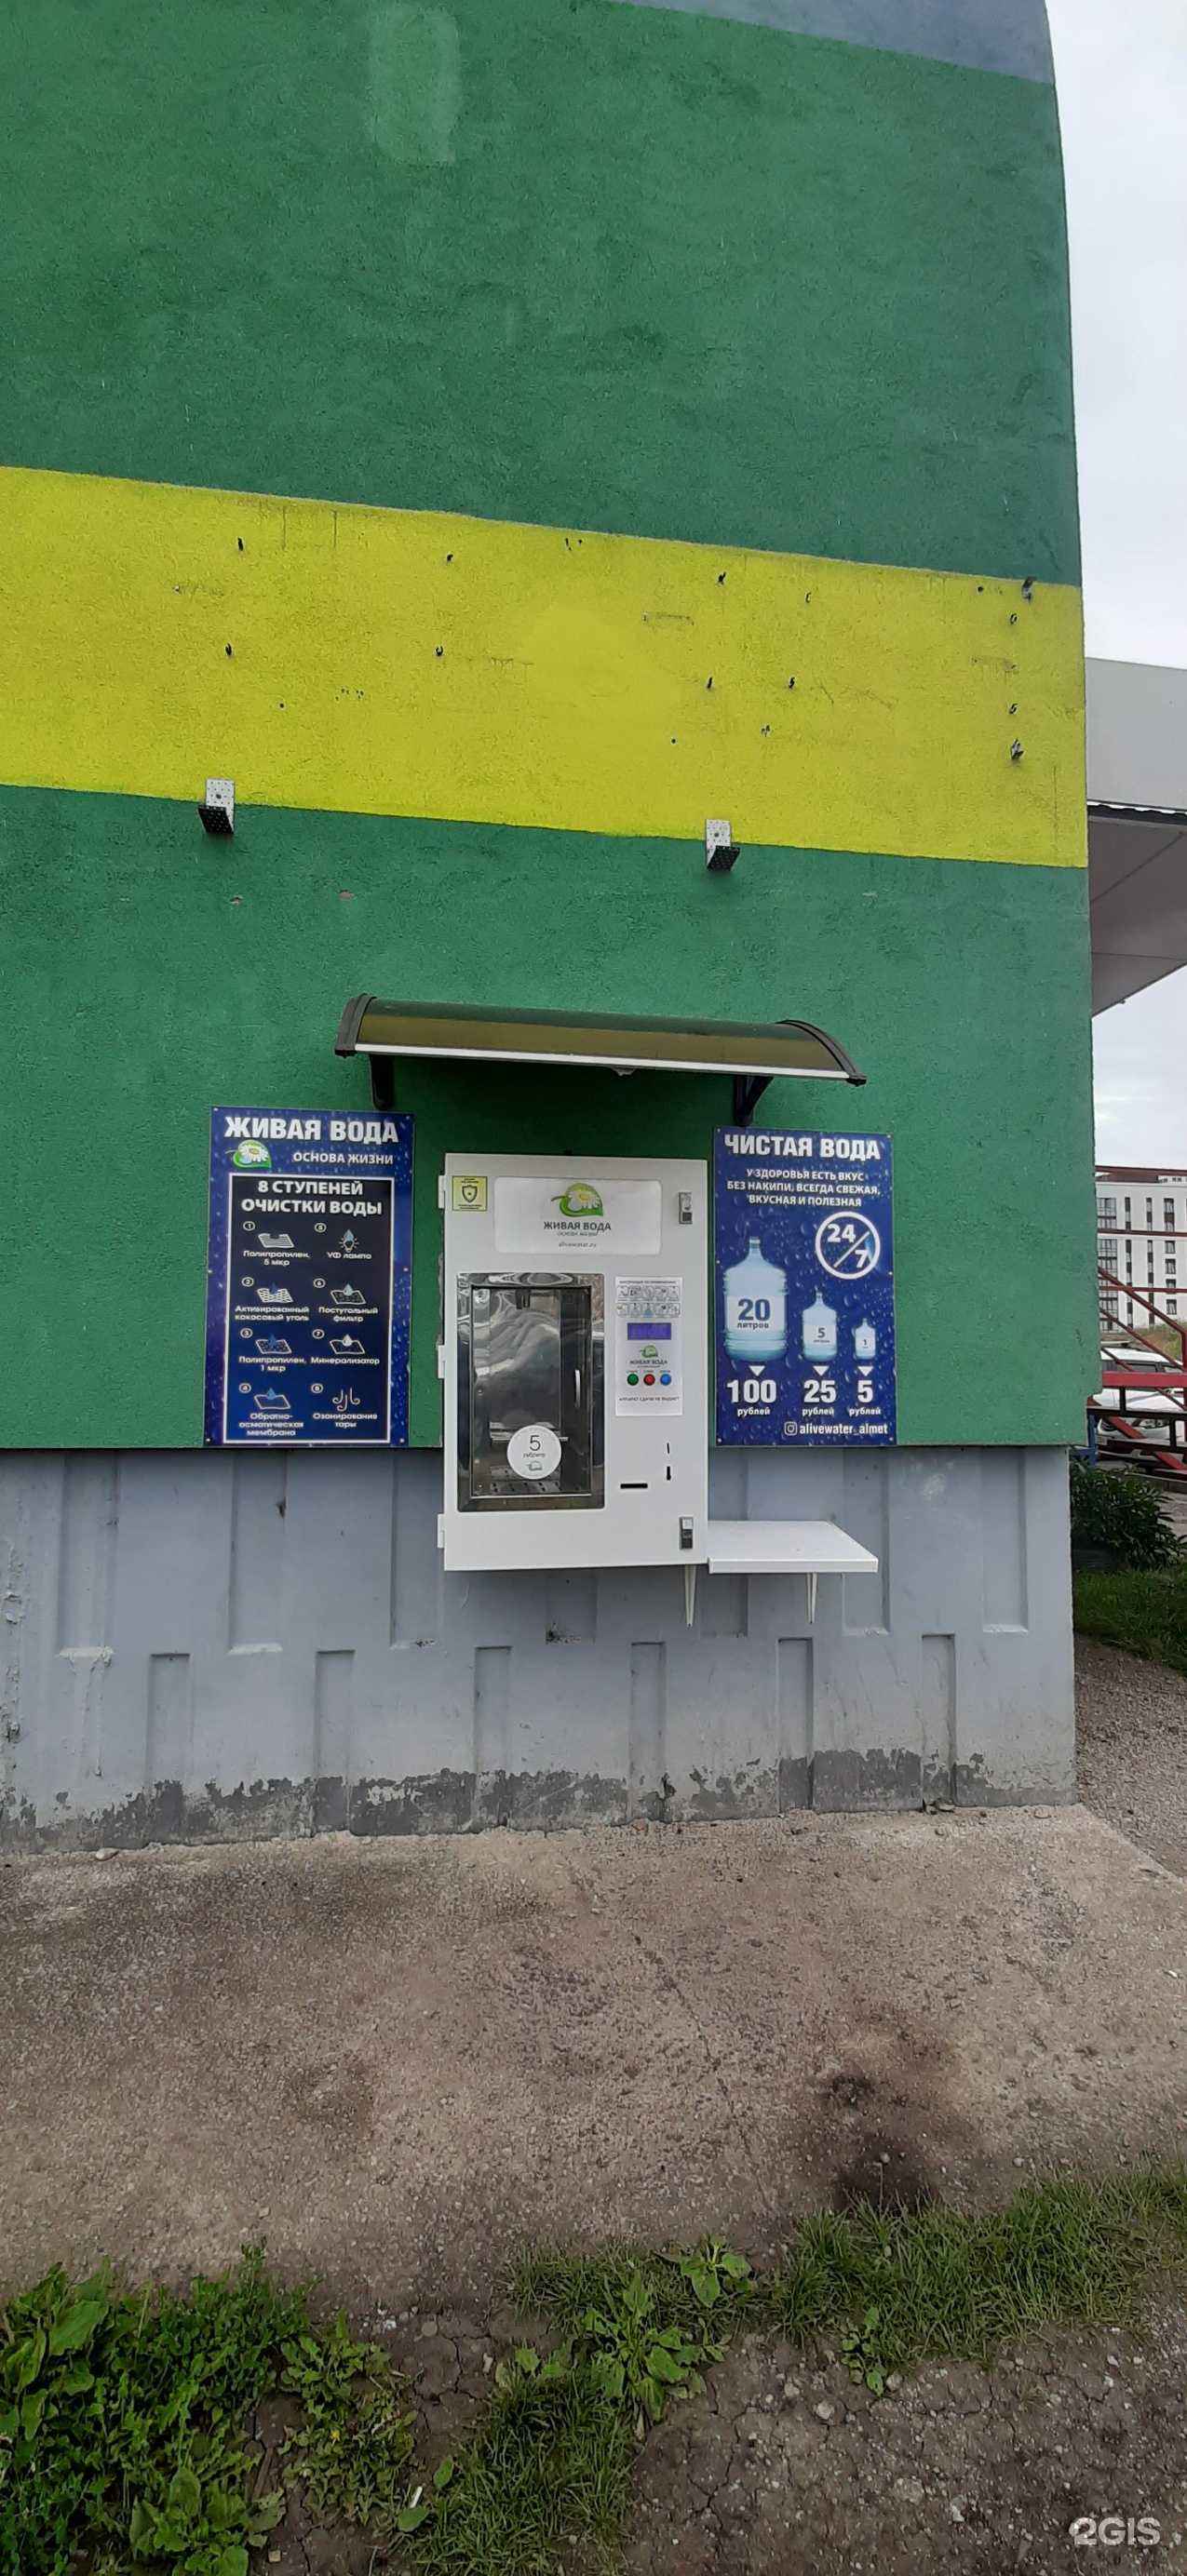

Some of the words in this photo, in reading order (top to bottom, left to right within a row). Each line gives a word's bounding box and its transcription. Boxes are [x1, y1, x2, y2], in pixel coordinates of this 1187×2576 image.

[223, 1117, 321, 1140] ЖИВАЯ
[330, 1120, 398, 1145] ВОДА
[724, 1134, 813, 1157] ЧИСТАЯ
[820, 1138, 881, 1161] ВОДА
[293, 1151, 345, 1163] ОСНОВА
[346, 1153, 393, 1164] ЖИЗНИ
[746, 1169, 753, 1177] У
[754, 1169, 810, 1179] ЗДОРОВЬЯ
[812, 1172, 836, 1180] ЕСТЬ
[838, 1173, 864, 1181] ВКУС
[258, 1180, 269, 1193] 8
[272, 1180, 363, 1195] СТУПЕНЕЙ
[727, 1180, 746, 1189] БЕЗ
[748, 1182, 794, 1192] НАКИПИ,
[796, 1184, 834, 1194] ВСЕГДА
[836, 1185, 881, 1195] СВЕЖАЯ,
[241, 1199, 326, 1214] ОЧИСТКИ
[330, 1201, 382, 1216] ВОДЫ
[749, 1195, 797, 1205] ВКУСНАЯ
[808, 1197, 862, 1207] ПОЛЕЗНАЯ
[544, 1221, 581, 1230] ЖИВАЯ
[583, 1222, 611, 1232] ВОДА
[827, 1224, 857, 1243] 24
[855, 1249, 869, 1268] 7
[737, 1298, 771, 1322] 20
[817, 1327, 826, 1338] 5
[726, 1379, 777, 1403] 100
[803, 1379, 837, 1403] 25
[857, 1379, 873, 1403] 5
[736, 1406, 771, 1417] рублей
[802, 1406, 834, 1417] рублей
[848, 1406, 882, 1417] рублей
[800, 1423, 888, 1435] alivewater_almet
[530, 1434, 541, 1451] 5
